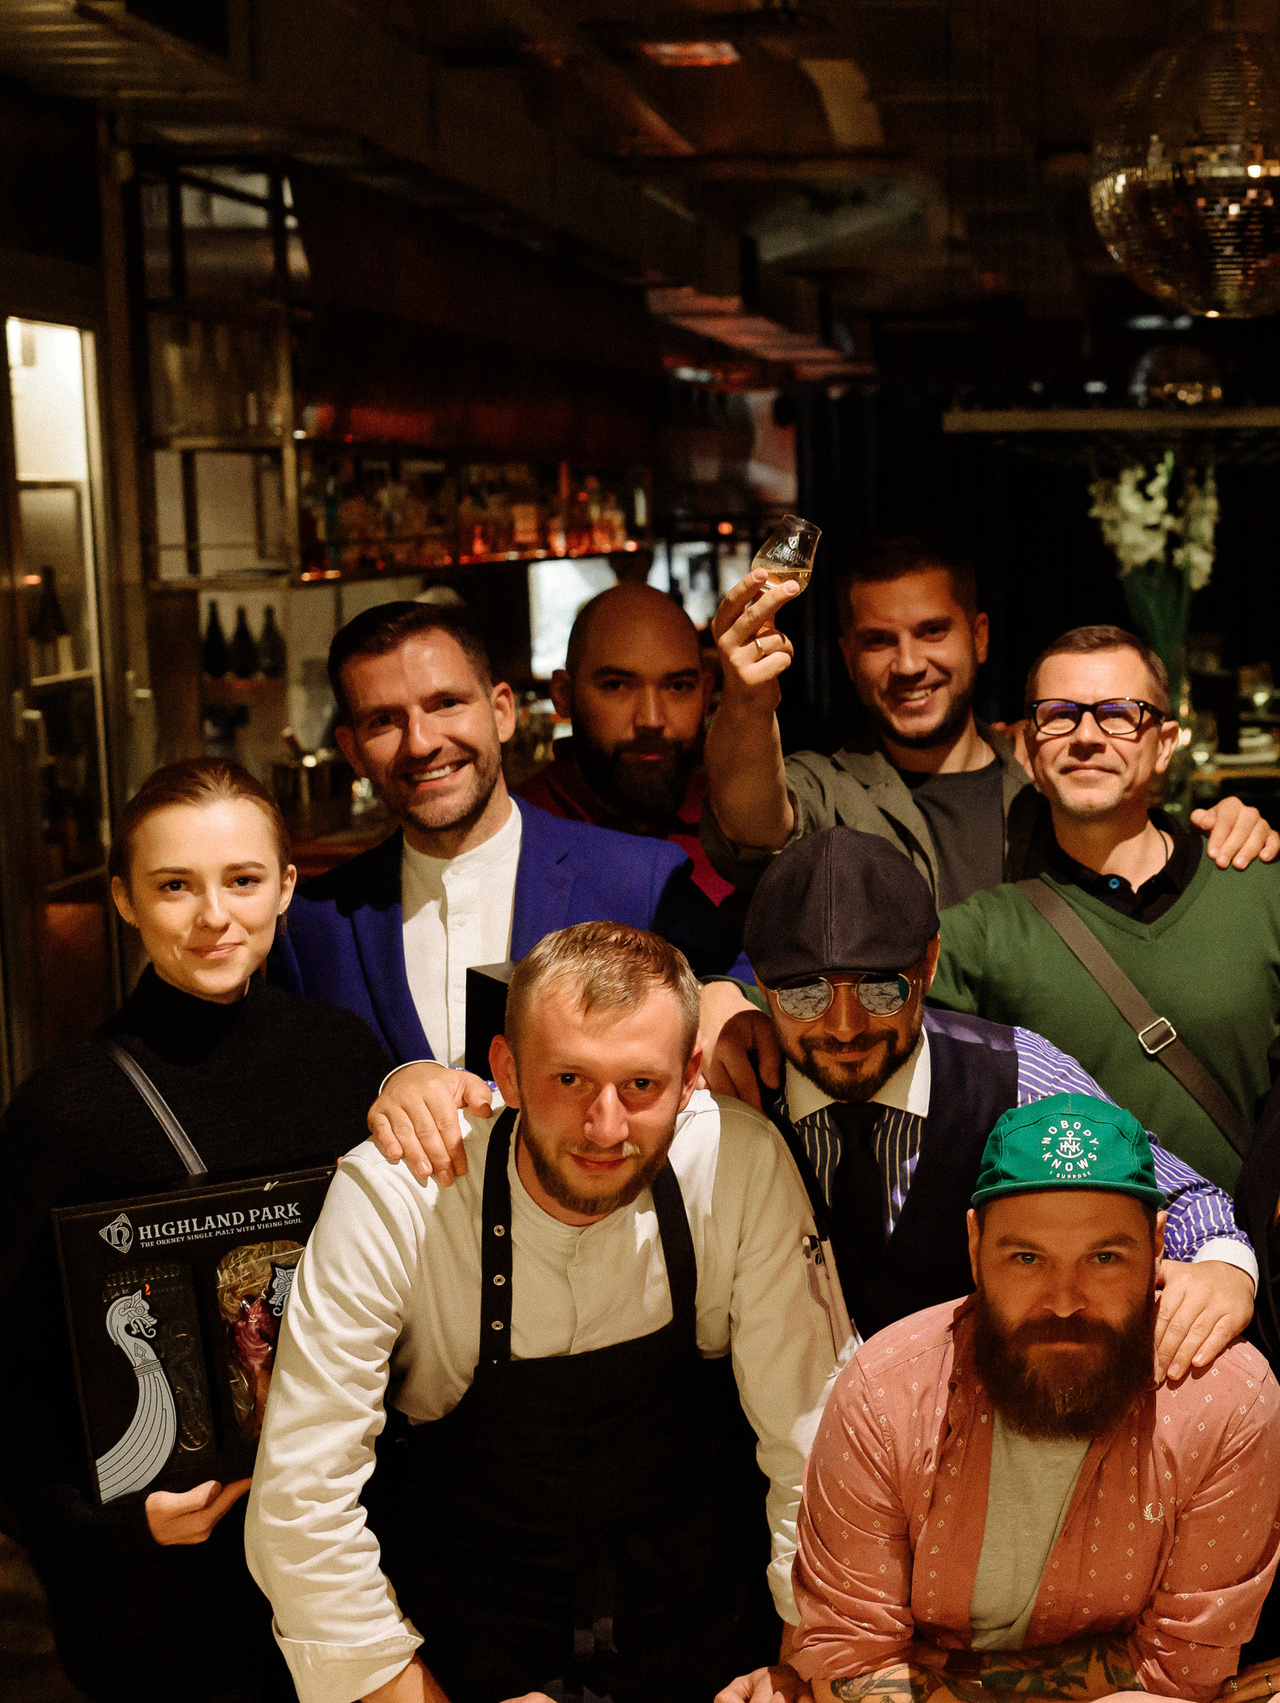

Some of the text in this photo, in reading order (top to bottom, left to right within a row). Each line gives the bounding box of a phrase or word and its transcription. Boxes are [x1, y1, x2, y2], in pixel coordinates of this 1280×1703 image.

[1041, 1120, 1100, 1145] NOBODY
[1041, 1151, 1098, 1172] KNOWS
[1056, 1170, 1092, 1179] SUPPOSE
[138, 1202, 301, 1241] HIGHLAND PARK
[140, 1218, 302, 1249] THE ORKNEY SINGLE MALT WITH VIKING SOUL
